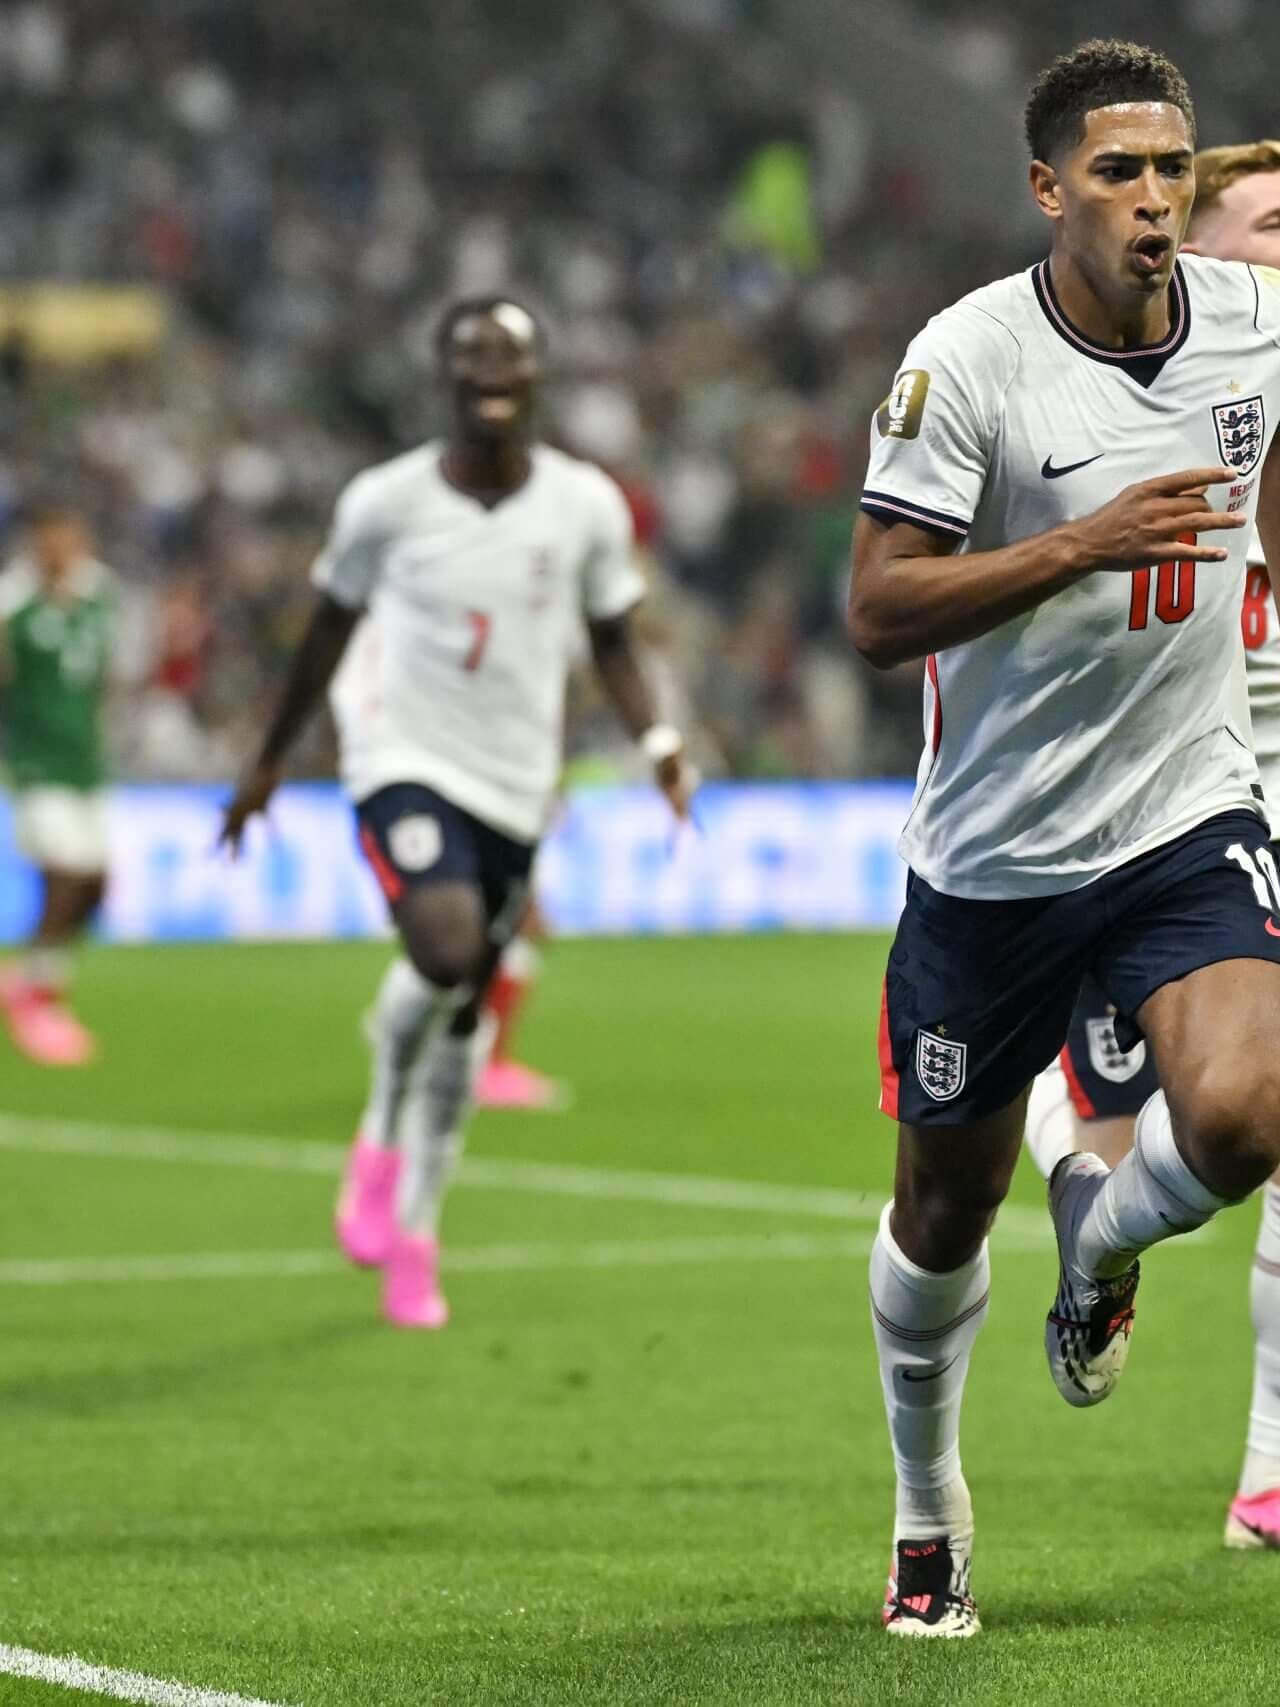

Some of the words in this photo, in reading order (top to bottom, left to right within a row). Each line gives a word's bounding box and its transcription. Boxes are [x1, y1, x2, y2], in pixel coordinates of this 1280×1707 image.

[1128, 532, 1198, 631] 10
[1241, 564, 1272, 651] 8
[464, 611, 491, 672] 7
